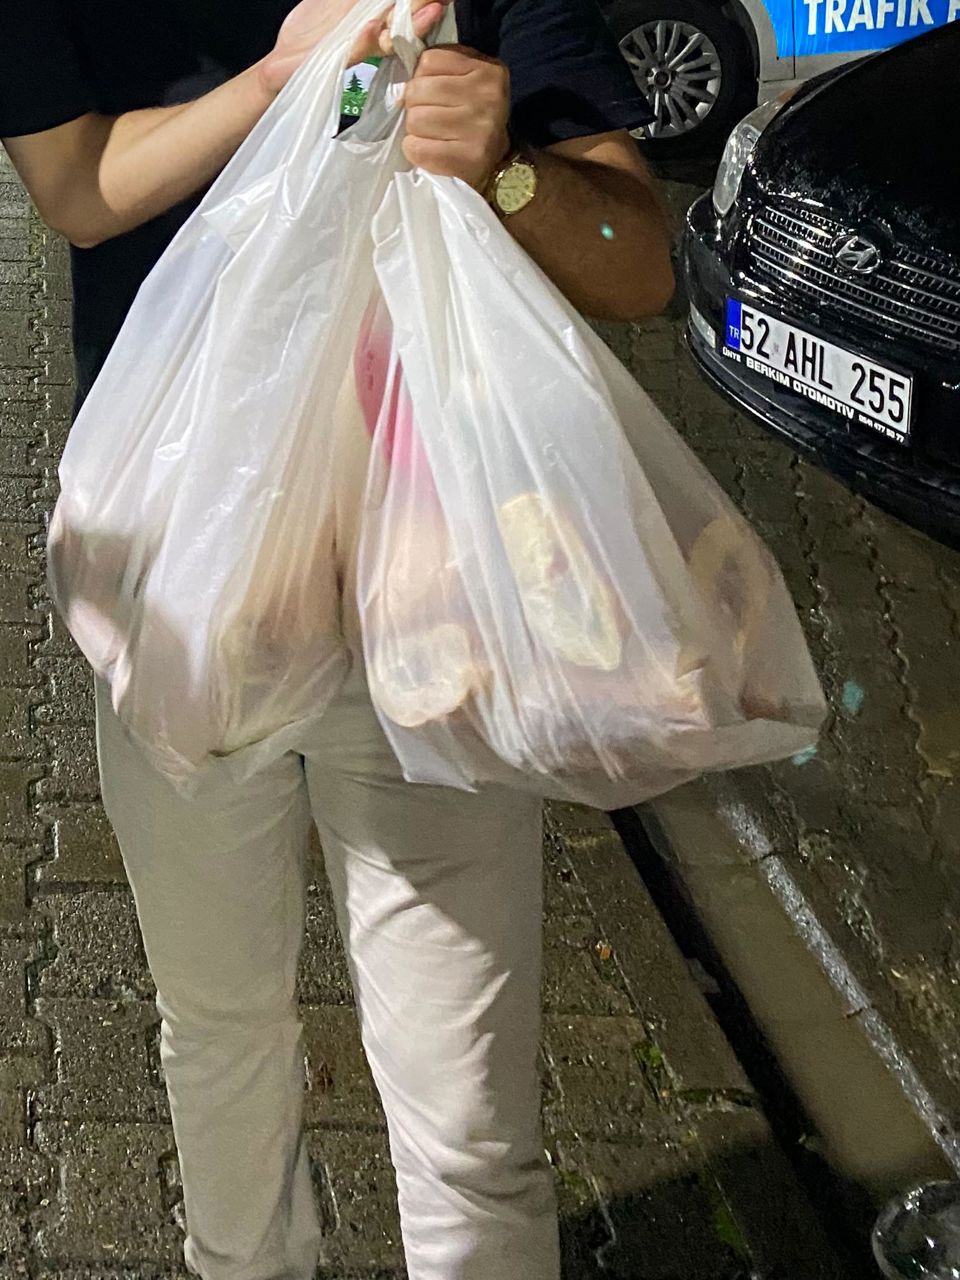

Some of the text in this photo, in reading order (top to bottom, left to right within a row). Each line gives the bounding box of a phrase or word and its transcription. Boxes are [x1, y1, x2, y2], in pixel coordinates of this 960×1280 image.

[343, 105, 365, 115] 20
[729, 324, 740, 340] TR
[741, 309, 906, 423] 52 AHL 255
